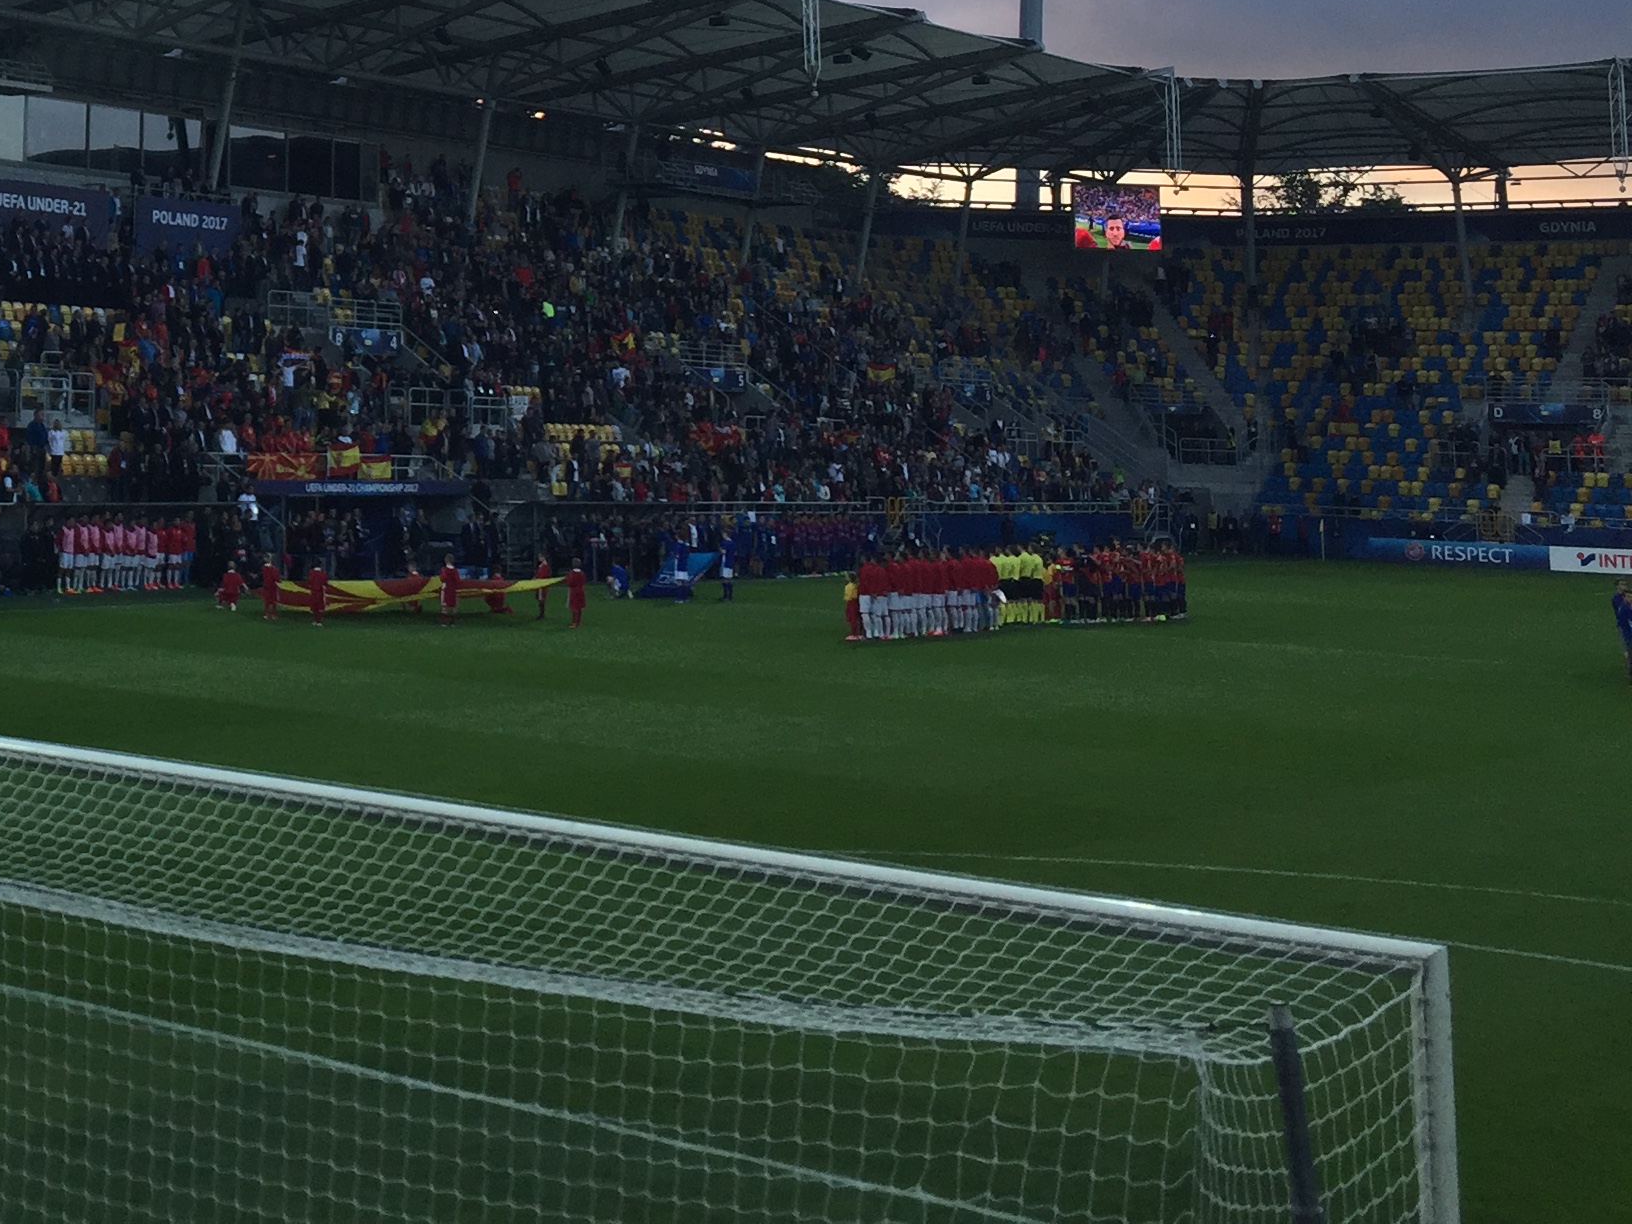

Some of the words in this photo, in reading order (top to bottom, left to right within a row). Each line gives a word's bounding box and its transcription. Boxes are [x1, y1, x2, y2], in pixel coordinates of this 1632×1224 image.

[27, 195, 87, 216] UNDER-21
[152, 209, 200, 228] POLAND
[201, 214, 228, 230] 2017
[972, 220, 1006, 232] UEFA
[1294, 227, 1327, 239] 2017
[1539, 221, 1597, 233] GDYNIA
[335, 332, 344, 347] B
[389, 335, 398, 350] 4
[738, 374, 745, 387] 5
[1493, 407, 1504, 418] D
[1592, 408, 1603, 420] 8
[1431, 544, 1514, 564] RESPECT
